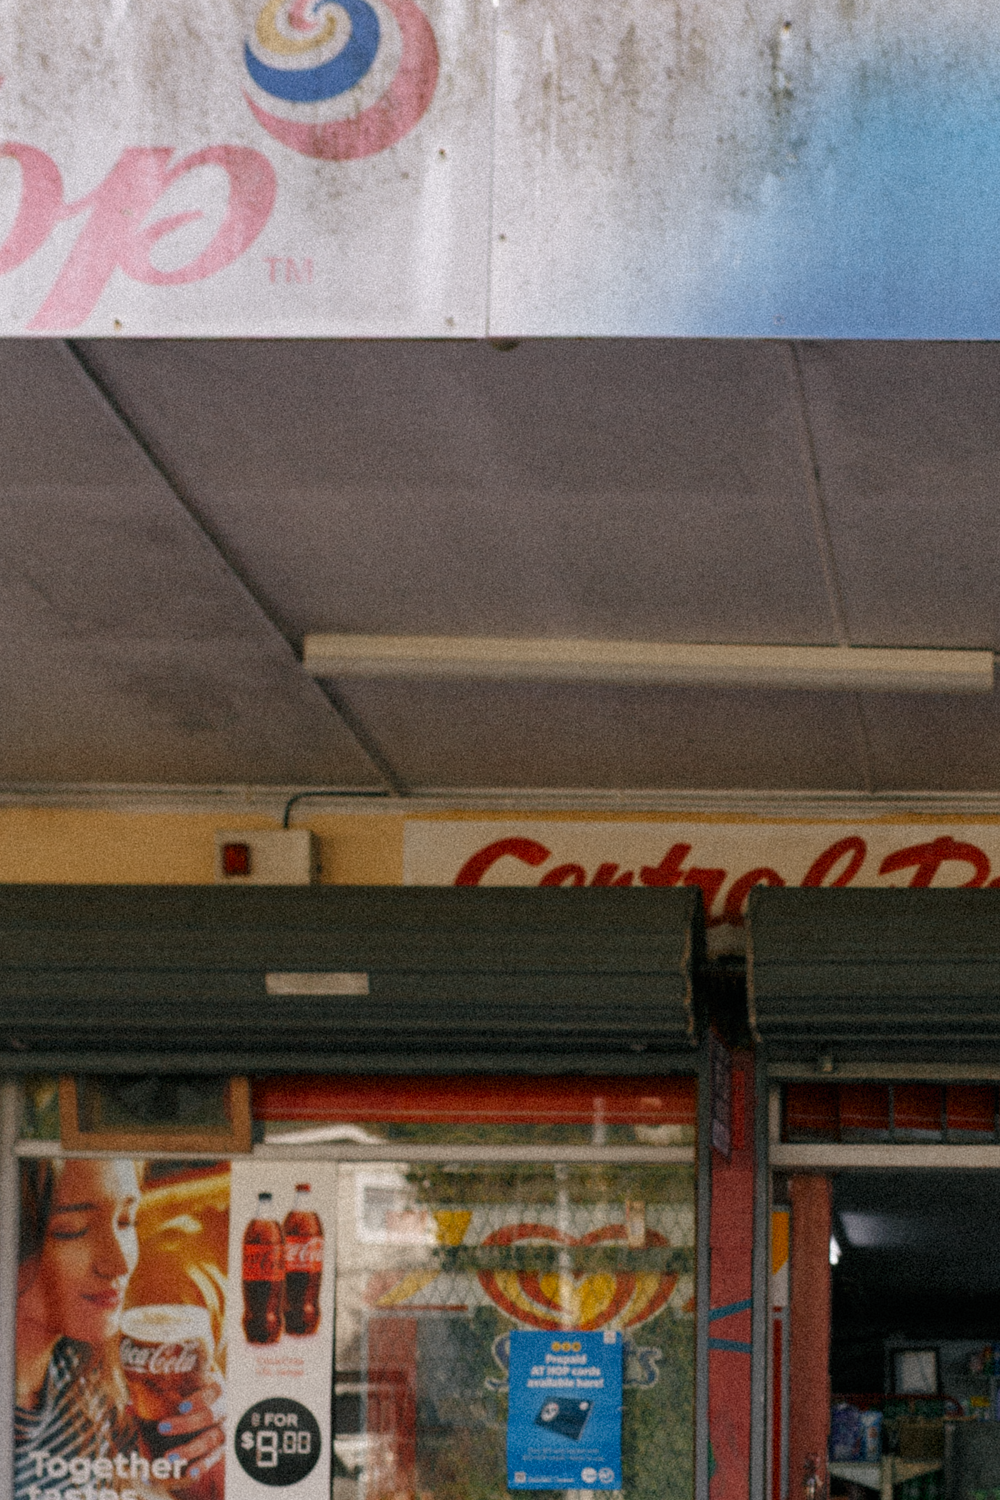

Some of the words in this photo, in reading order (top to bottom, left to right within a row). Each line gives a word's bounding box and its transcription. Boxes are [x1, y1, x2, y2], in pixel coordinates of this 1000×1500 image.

[119, 1337, 199, 1375] Coca-Cola
[545, 1353, 587, 1365] Prepaid
[526, 1378, 575, 1389] available
[264, 1412, 298, 1428] FOR
[28, 1451, 188, 1483] Together
